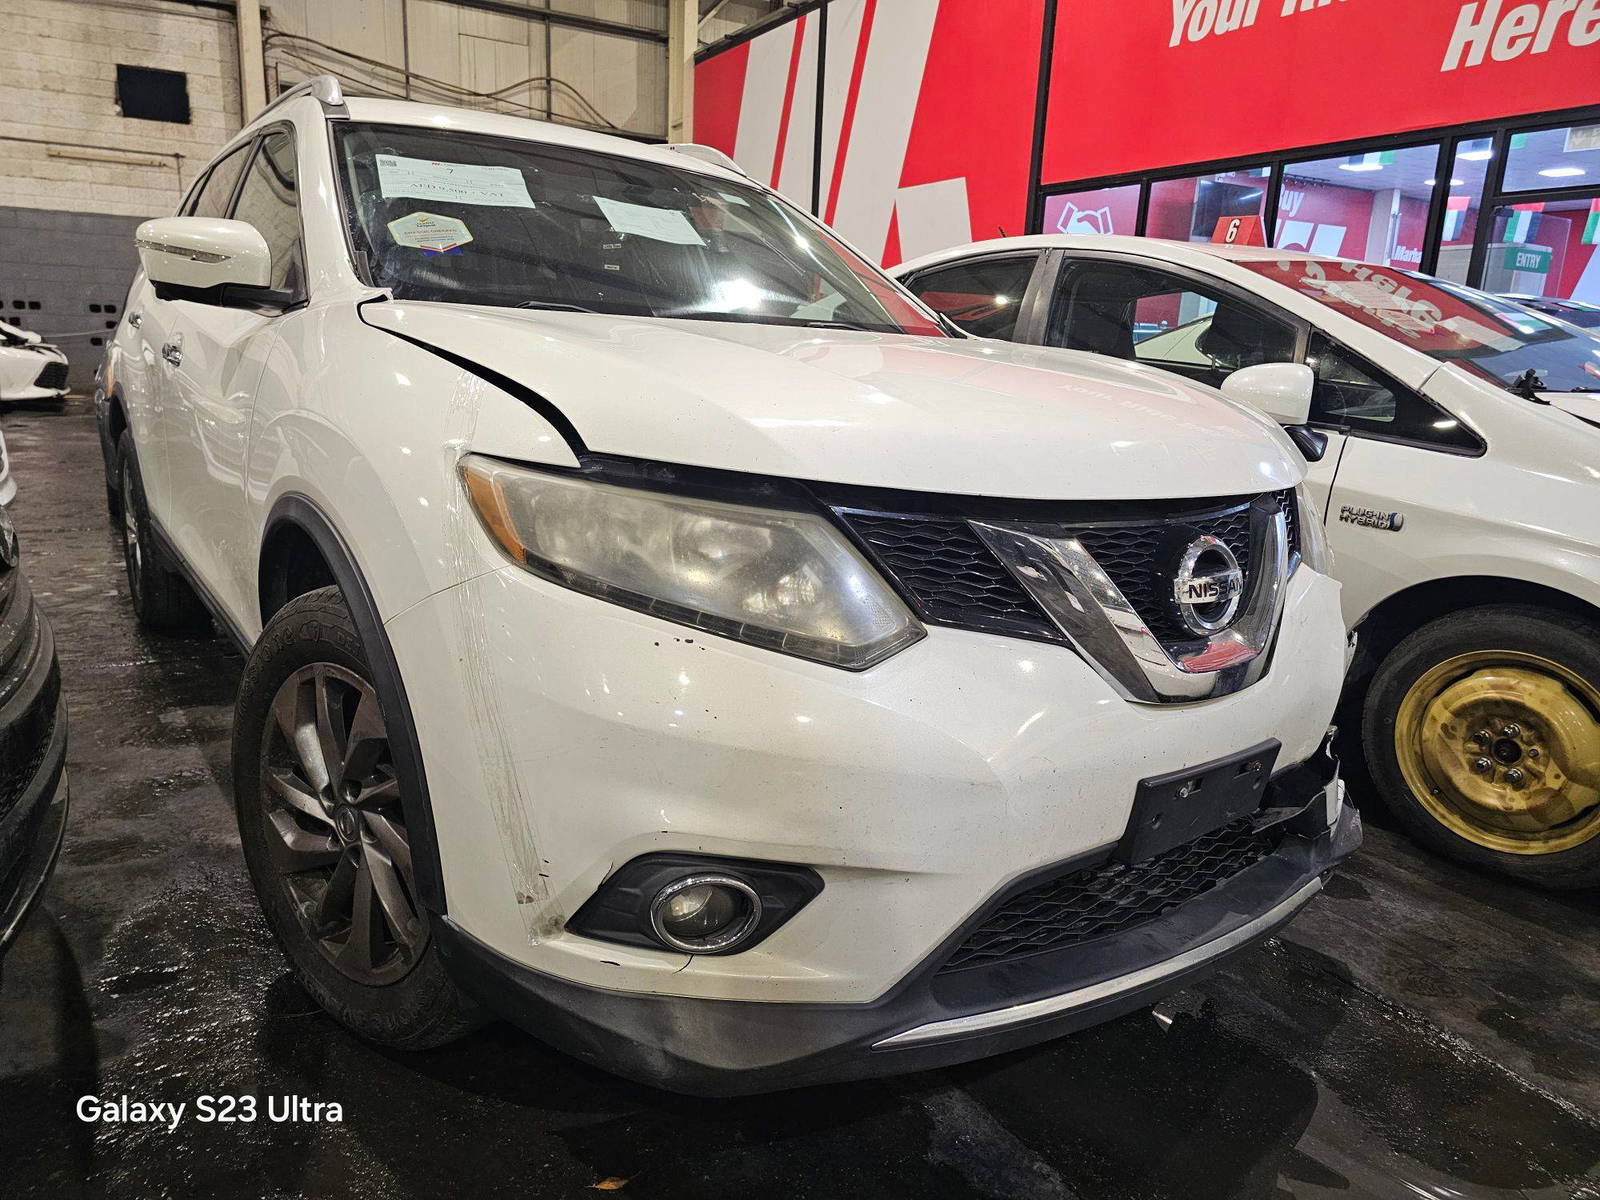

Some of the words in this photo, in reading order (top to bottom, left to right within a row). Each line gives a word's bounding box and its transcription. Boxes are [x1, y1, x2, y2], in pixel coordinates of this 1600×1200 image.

[1169, 0, 1260, 47] Your
[1441, 0, 1600, 72] Here
[1226, 218, 1240, 239] 6
[1514, 251, 1542, 270] ENTRY
[1339, 513, 1390, 530] HYBRID
[1341, 505, 1390, 521] PLUG-IN
[1188, 578, 1243, 599] NISSAN
